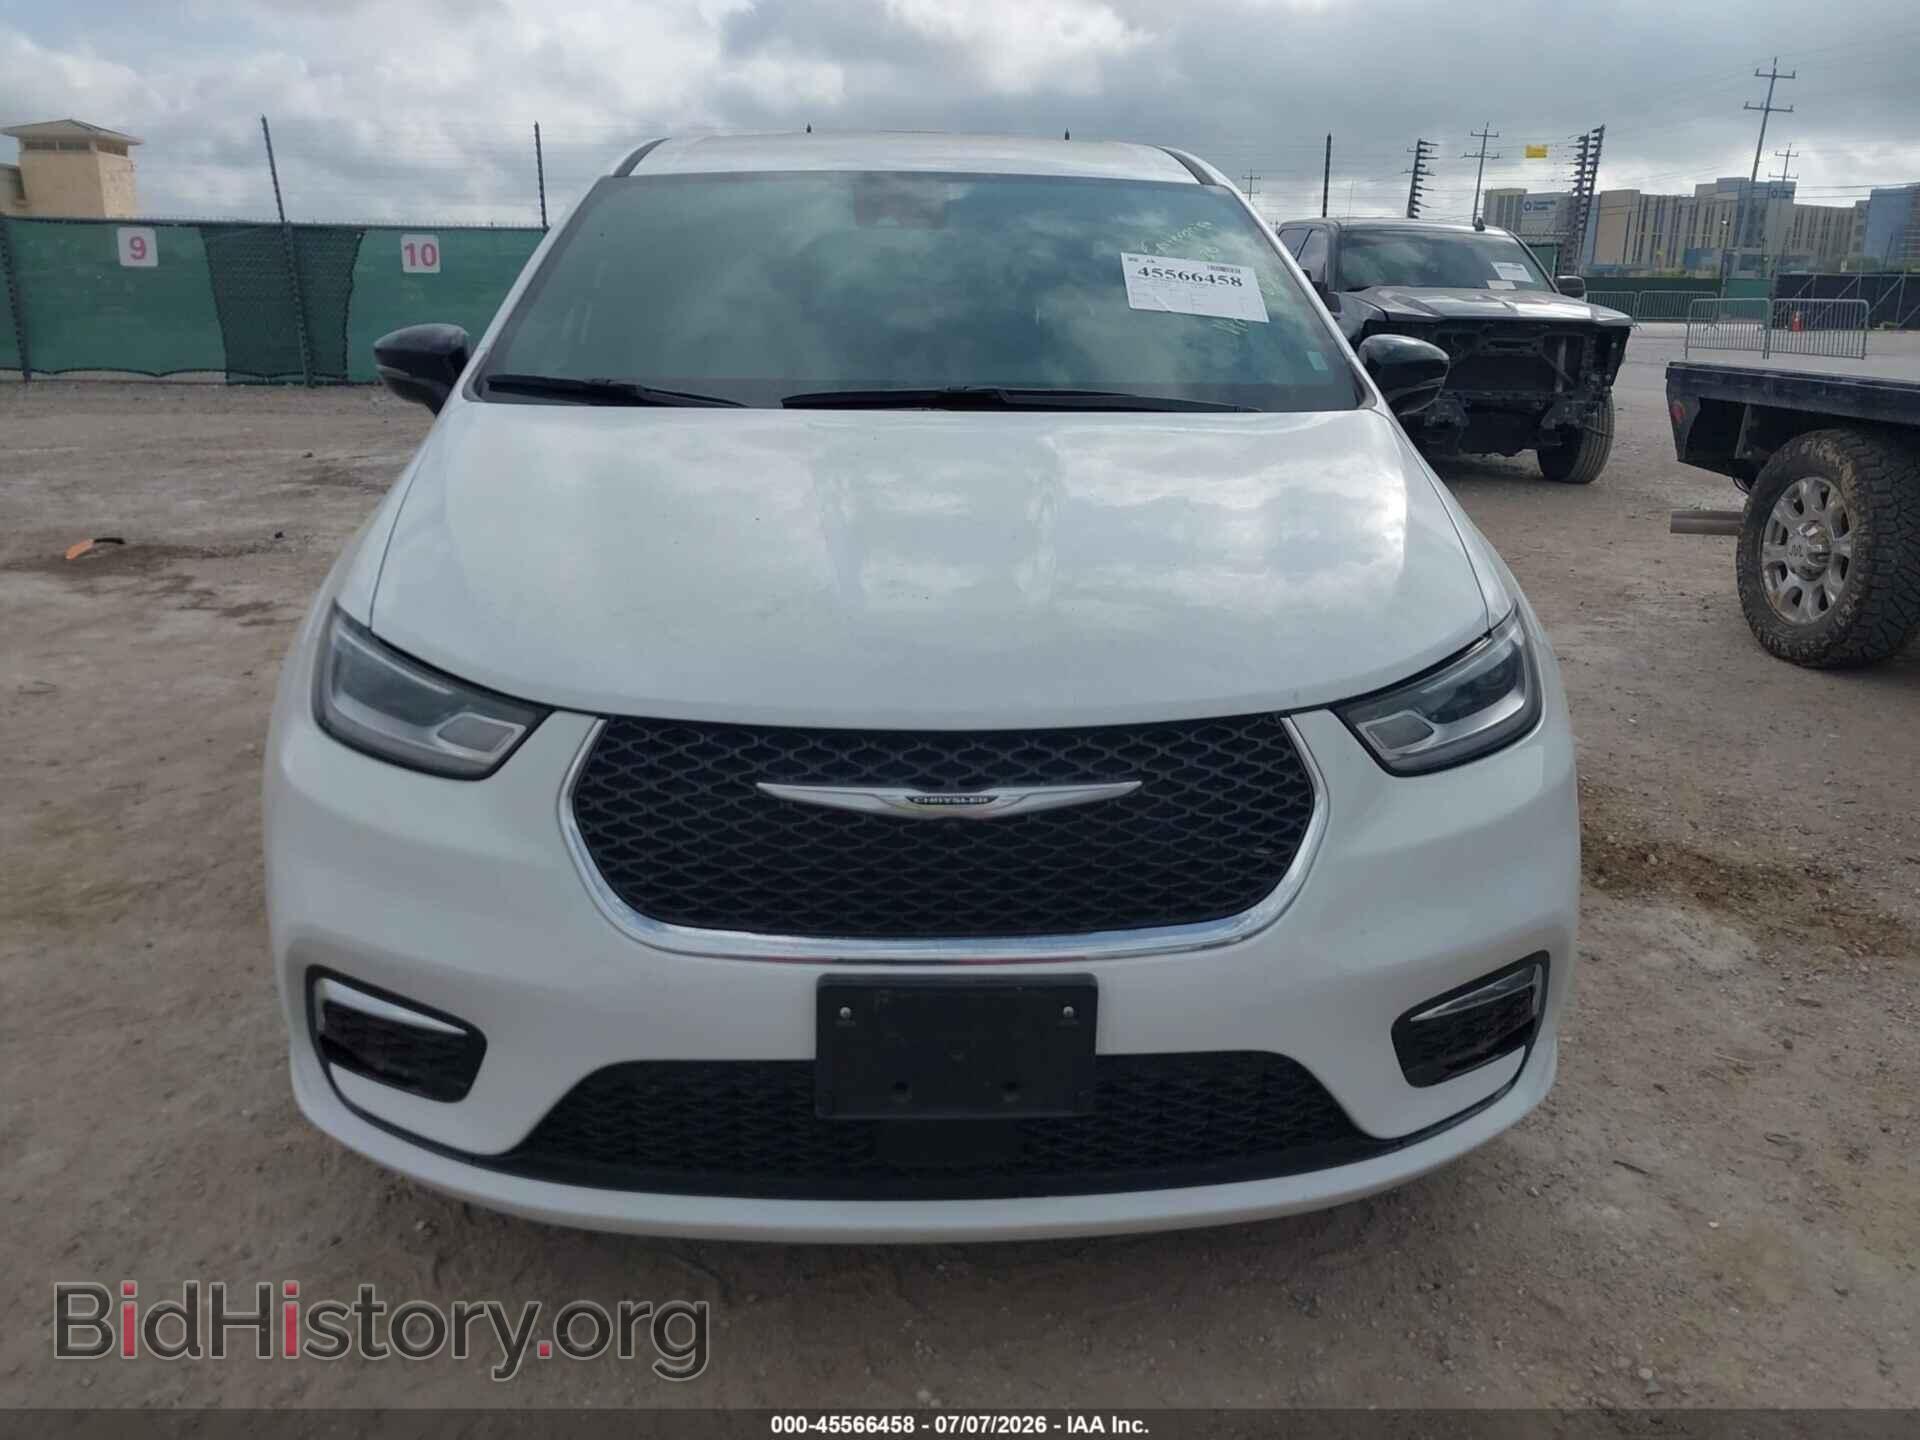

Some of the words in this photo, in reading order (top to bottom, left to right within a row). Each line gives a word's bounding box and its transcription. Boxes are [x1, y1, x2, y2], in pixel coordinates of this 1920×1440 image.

[129, 236, 147, 260] 9
[404, 243, 437, 267] 10
[1137, 266, 1243, 288] 45566458
